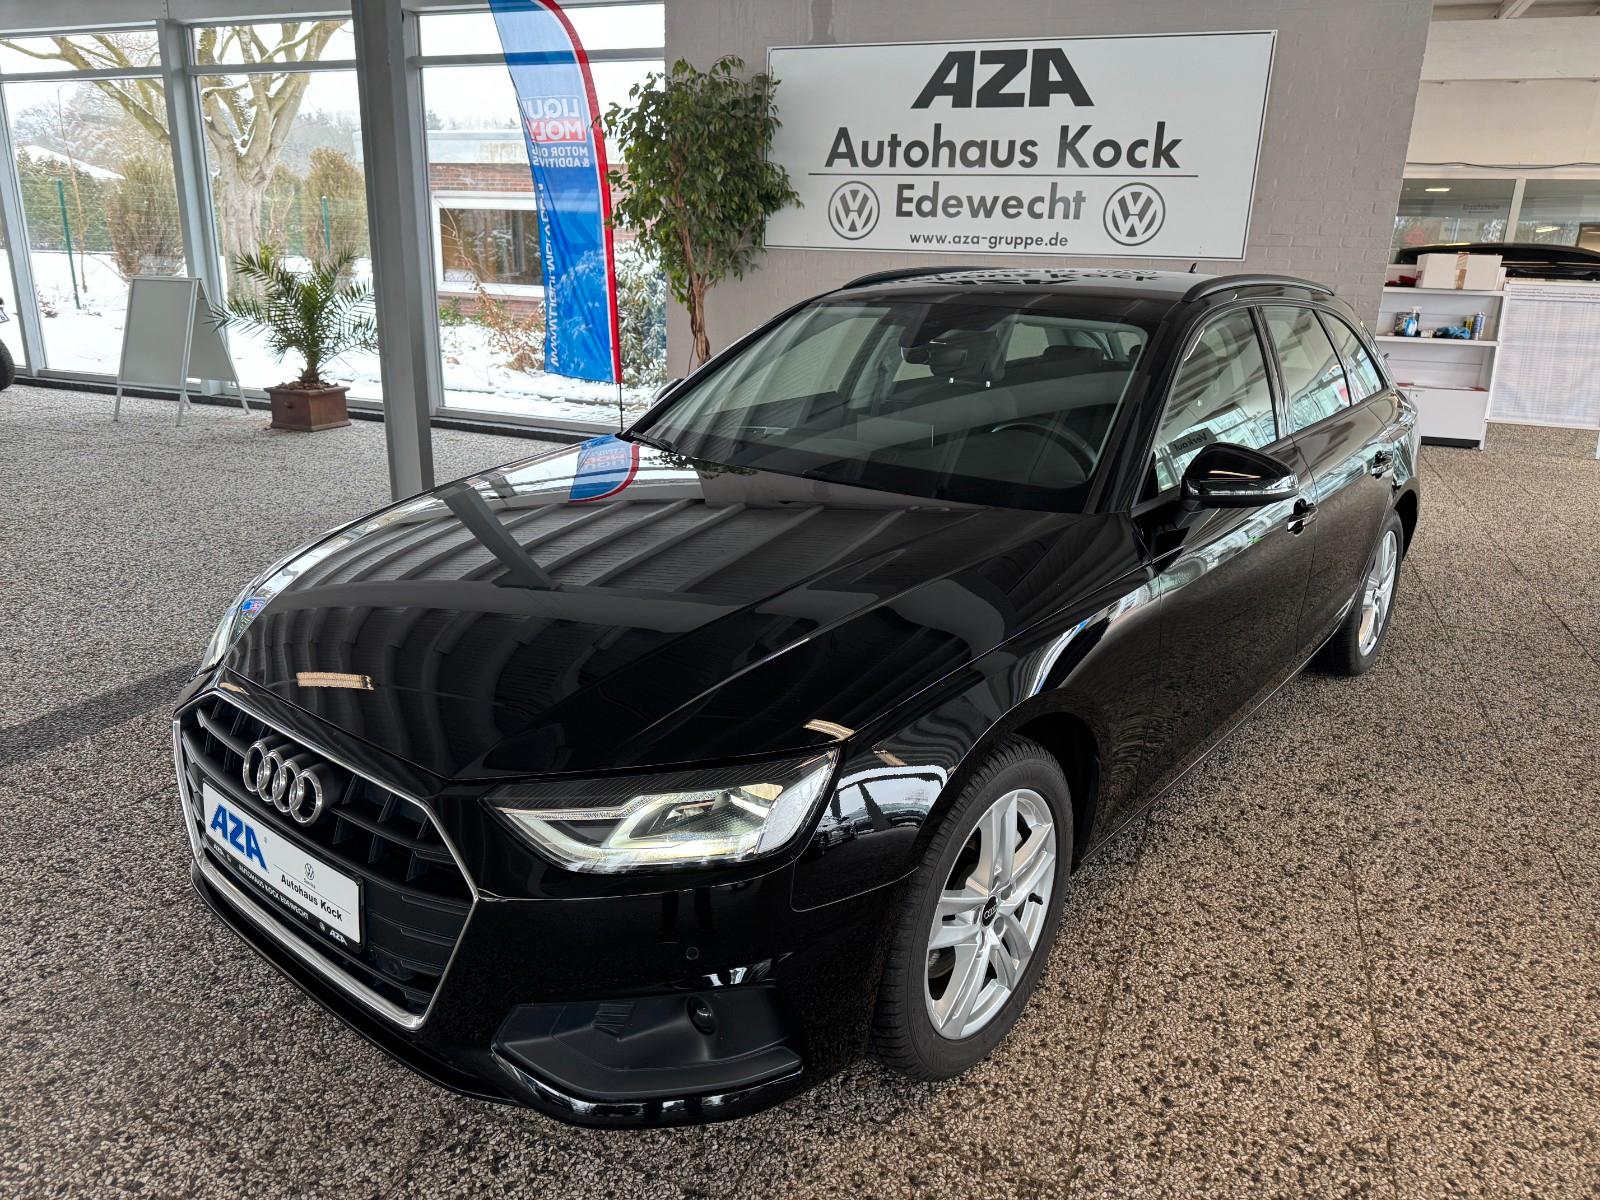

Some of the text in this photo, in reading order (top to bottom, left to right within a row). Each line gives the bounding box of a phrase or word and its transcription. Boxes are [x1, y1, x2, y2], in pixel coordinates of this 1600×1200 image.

[910, 48, 1095, 109] AZA
[825, 121, 1183, 169] Autohaus Kock
[896, 181, 1086, 219] Edewecht
[910, 232, 1068, 249] www.aza-gruppe.de
[210, 804, 269, 874] AZA
[281, 874, 343, 922] Autohaus Kock
[329, 929, 348, 946] AZA
